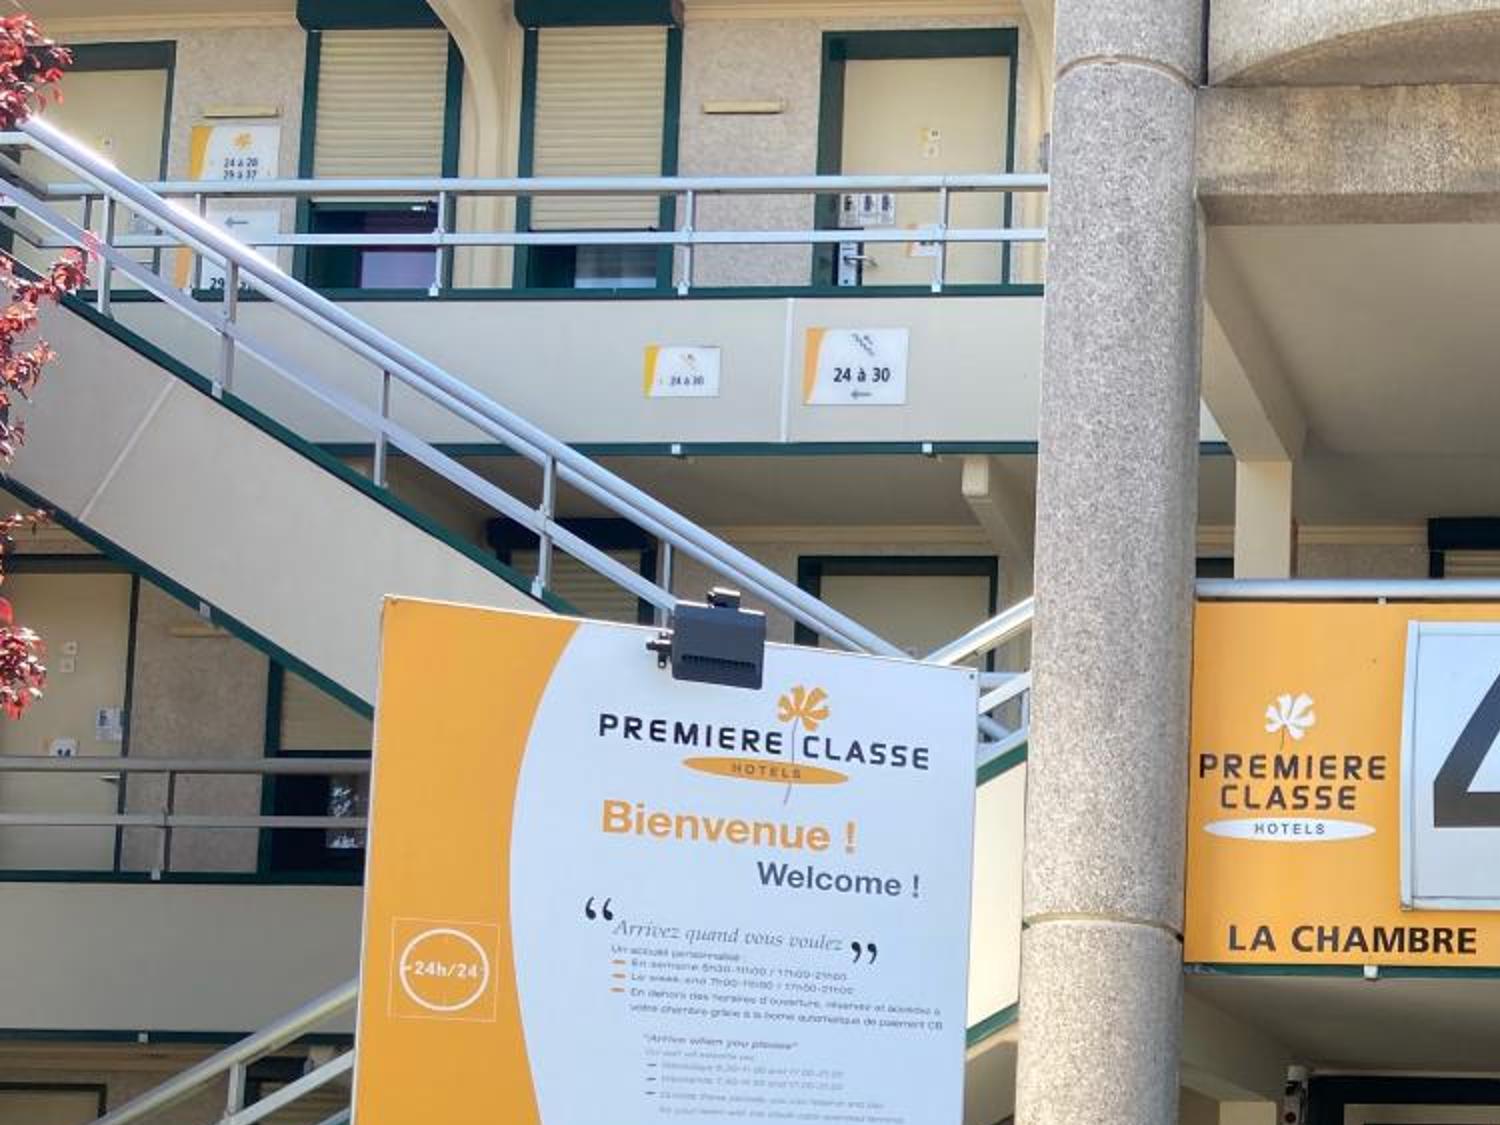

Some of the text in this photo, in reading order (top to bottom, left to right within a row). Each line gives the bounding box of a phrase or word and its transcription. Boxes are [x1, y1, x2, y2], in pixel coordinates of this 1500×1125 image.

[833, 366, 890, 383] 24 à 30
[599, 713, 929, 771] PREMIERE CLASSE
[731, 762, 801, 780] HOTELS
[1199, 753, 1387, 780] PREMIERE
[1221, 784, 1357, 811] CLASSE
[602, 799, 831, 852] Bienvenue
[1254, 822, 1326, 836] HOTELS
[757, 861, 902, 897] Welcome
[613, 919, 845, 952] Arrivez quand vous voulez
[1228, 925, 1277, 952] LA
[1290, 925, 1477, 955] CHAMBRE
[415, 960, 478, 978] 24h/24
